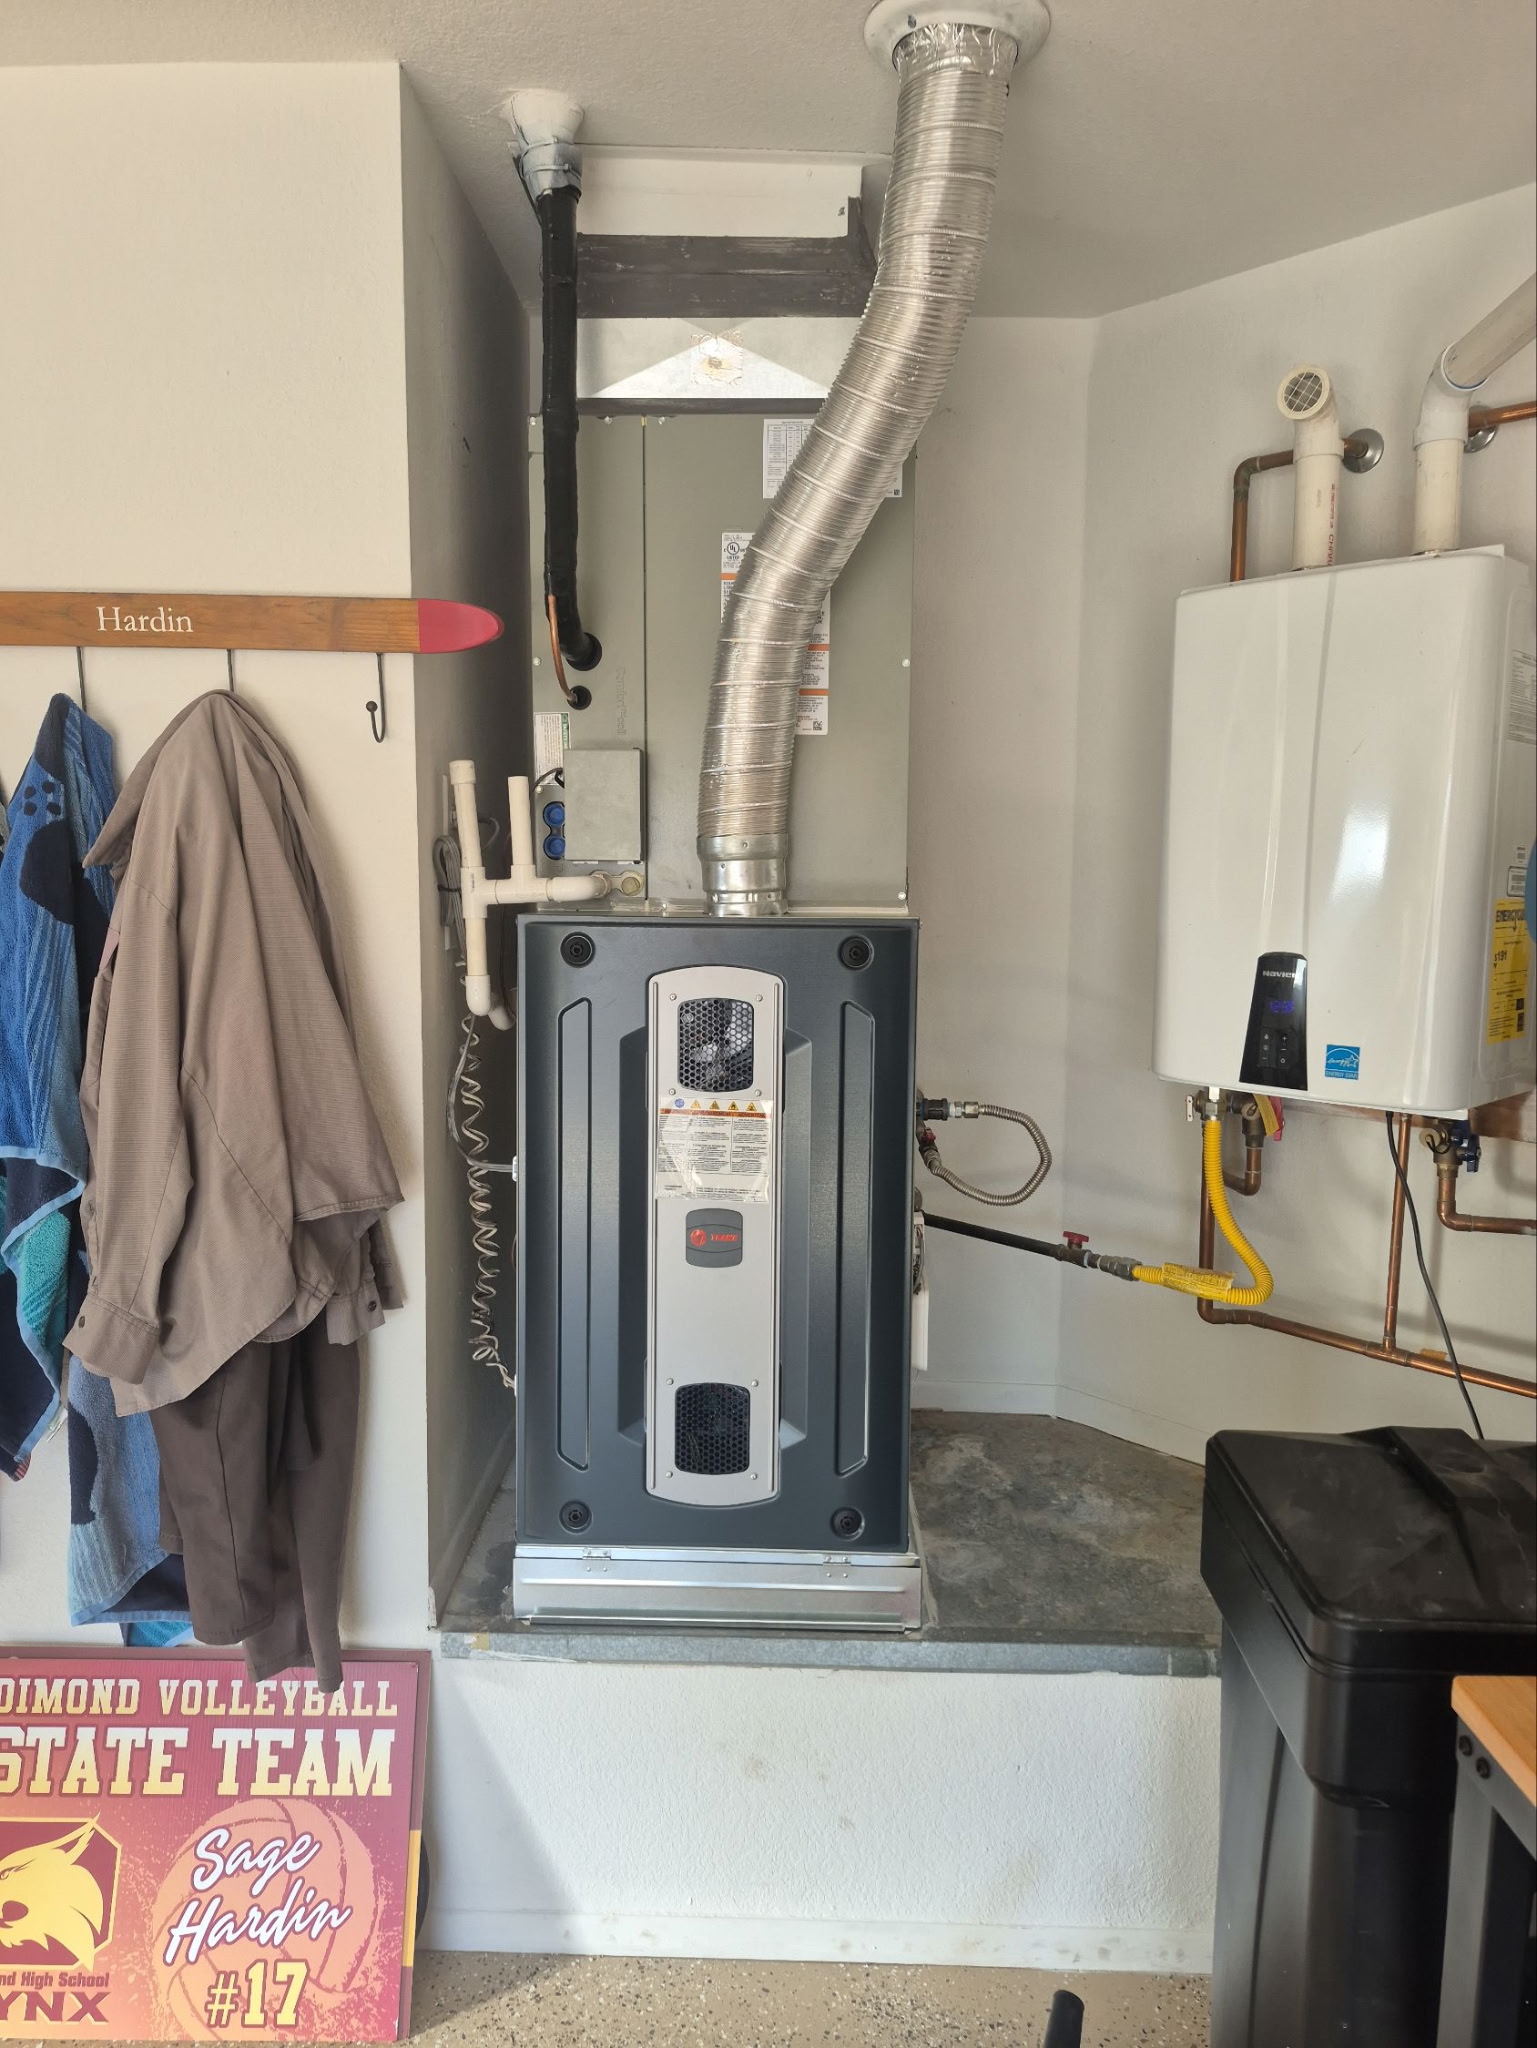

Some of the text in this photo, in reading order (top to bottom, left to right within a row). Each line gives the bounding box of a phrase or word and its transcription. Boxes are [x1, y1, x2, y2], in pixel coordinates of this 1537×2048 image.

[96, 606, 194, 632] Hardin
[159, 1679, 398, 1717] VOLLEYBALL
[0, 1726, 395, 1797] STATE TEAM
[192, 1826, 321, 1897] Sage
[163, 1877, 352, 1965] Hardin
[20, 1971, 54, 1991] High
[58, 1971, 110, 1988] School
[206, 1960, 309, 2026] #17
